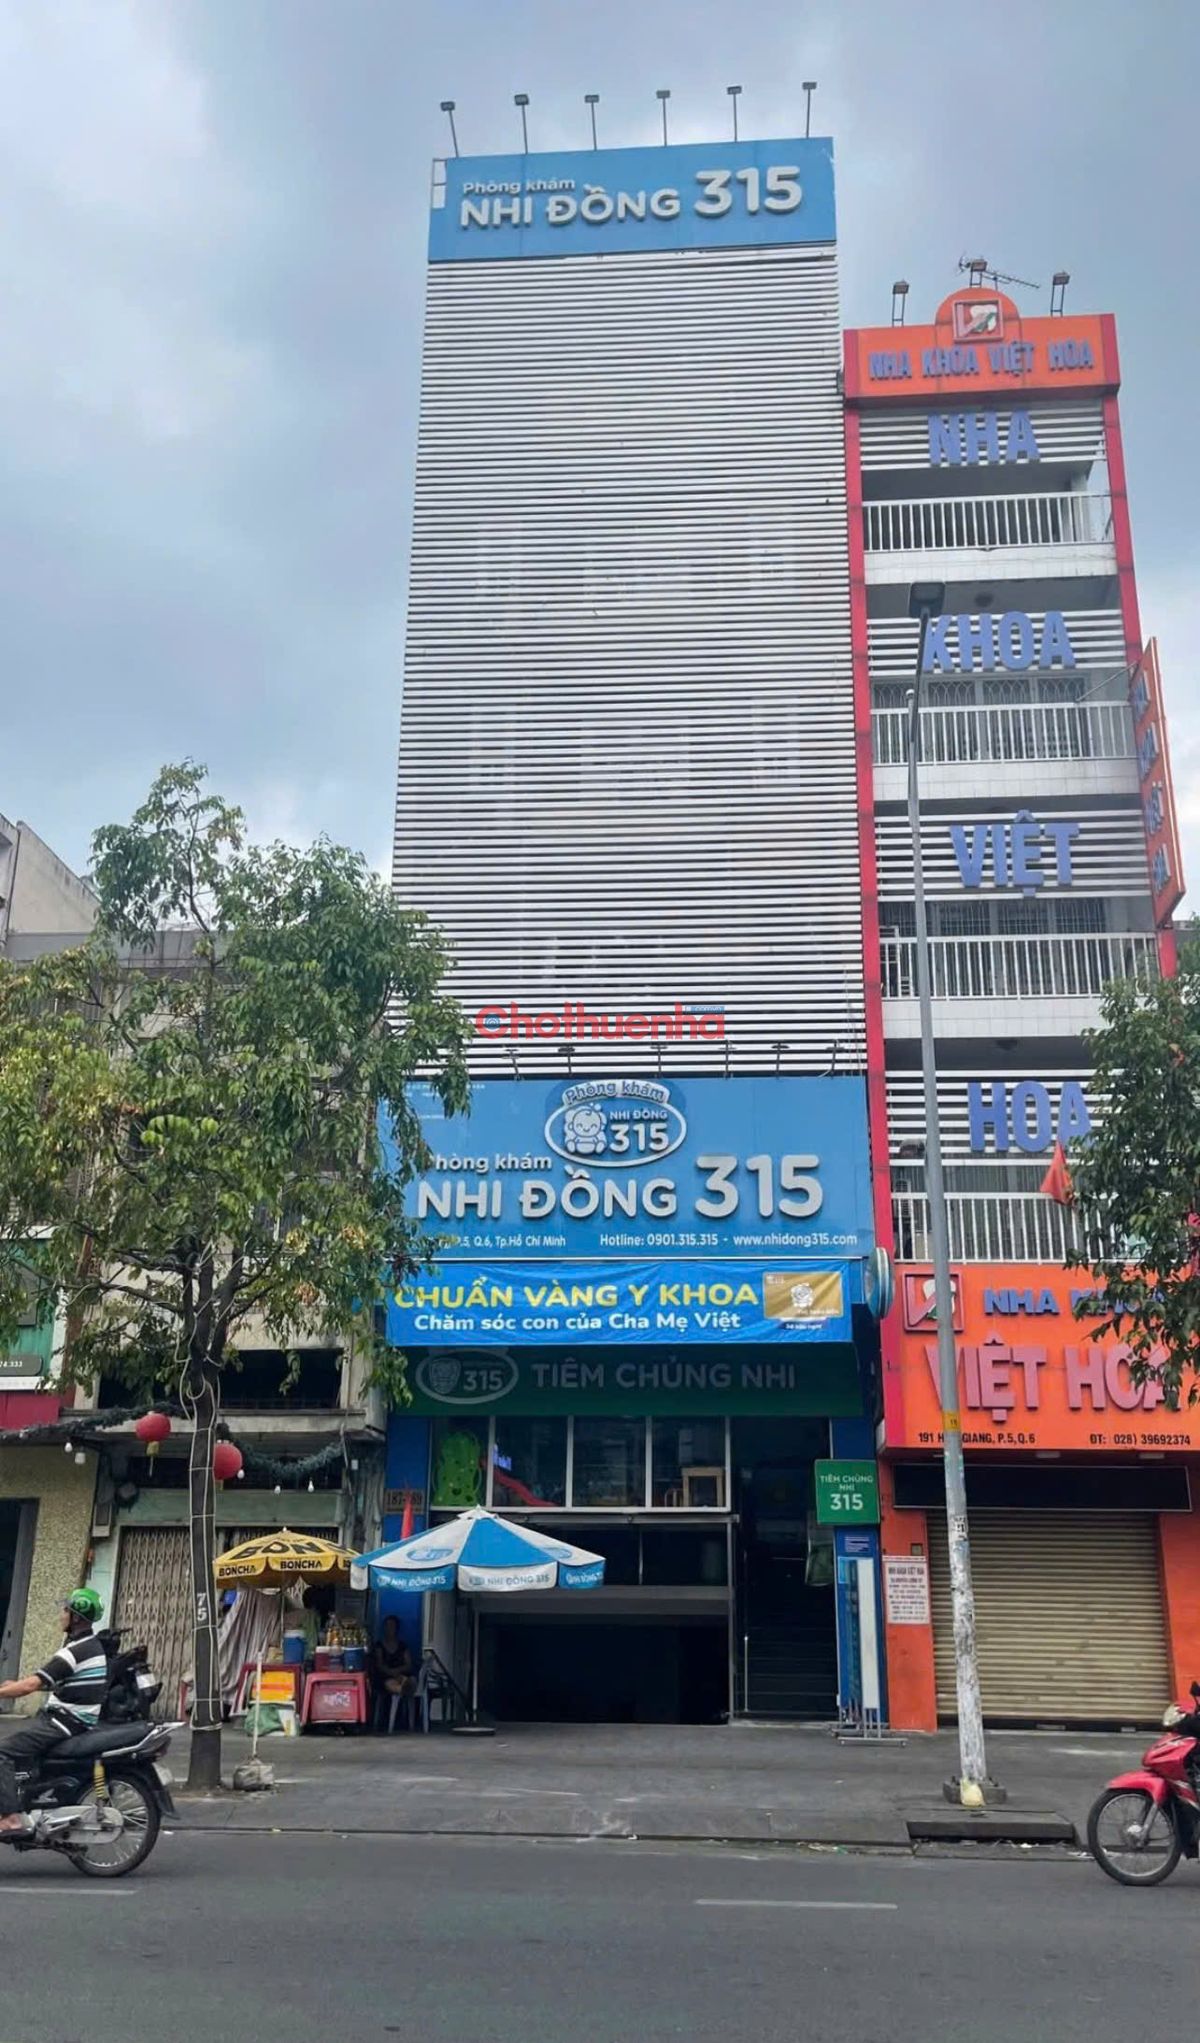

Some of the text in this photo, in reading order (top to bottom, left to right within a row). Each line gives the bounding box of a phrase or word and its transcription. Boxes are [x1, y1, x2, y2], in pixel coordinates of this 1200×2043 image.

[460, 165, 802, 228] NHI ĐỒNG 315
[463, 177, 576, 196] Phòng khám
[869, 339, 1095, 381] NHA KHOA VIỆT HOA
[928, 410, 1040, 466] NHA
[921, 610, 1077, 674] KHOA
[949, 809, 1079, 899] VIỆT
[565, 1080, 666, 1105] Phòng khám
[609, 1107, 668, 1120] NHI ĐỒNG
[967, 1080, 1094, 1153] HOA
[609, 1122, 670, 1153] 315
[432, 1152, 552, 1174] hòng khám
[418, 1154, 824, 1219] NHI ĐỒNG 315
[525, 1234, 542, 1247] Chí
[543, 1234, 567, 1247] Minh
[600, 1233, 645, 1247] Hotline:
[647, 1232, 719, 1247] 0901.315.315
[733, 1232, 858, 1249] www.nhidong315.com
[395, 1275, 760, 1309] CHUẨN VÀNG Y KHOA
[983, 1287, 1060, 1316] NHA
[414, 1309, 741, 1335] Chăm sóc con của Cha Mẹ Việt
[463, 1353, 796, 1392] 315 TIÊM CHỦNG NHI
[924, 1330, 1047, 1424] VIỆT
[918, 1432, 934, 1444] 191
[1140, 1433, 1192, 1446] 39692374
[820, 1474, 840, 1484] TIÊM
[839, 1484, 855, 1492] NHI
[830, 1493, 864, 1511] 315
[218, 1564, 258, 1577] BONCHA
[280, 1559, 322, 1570] BONCHA
